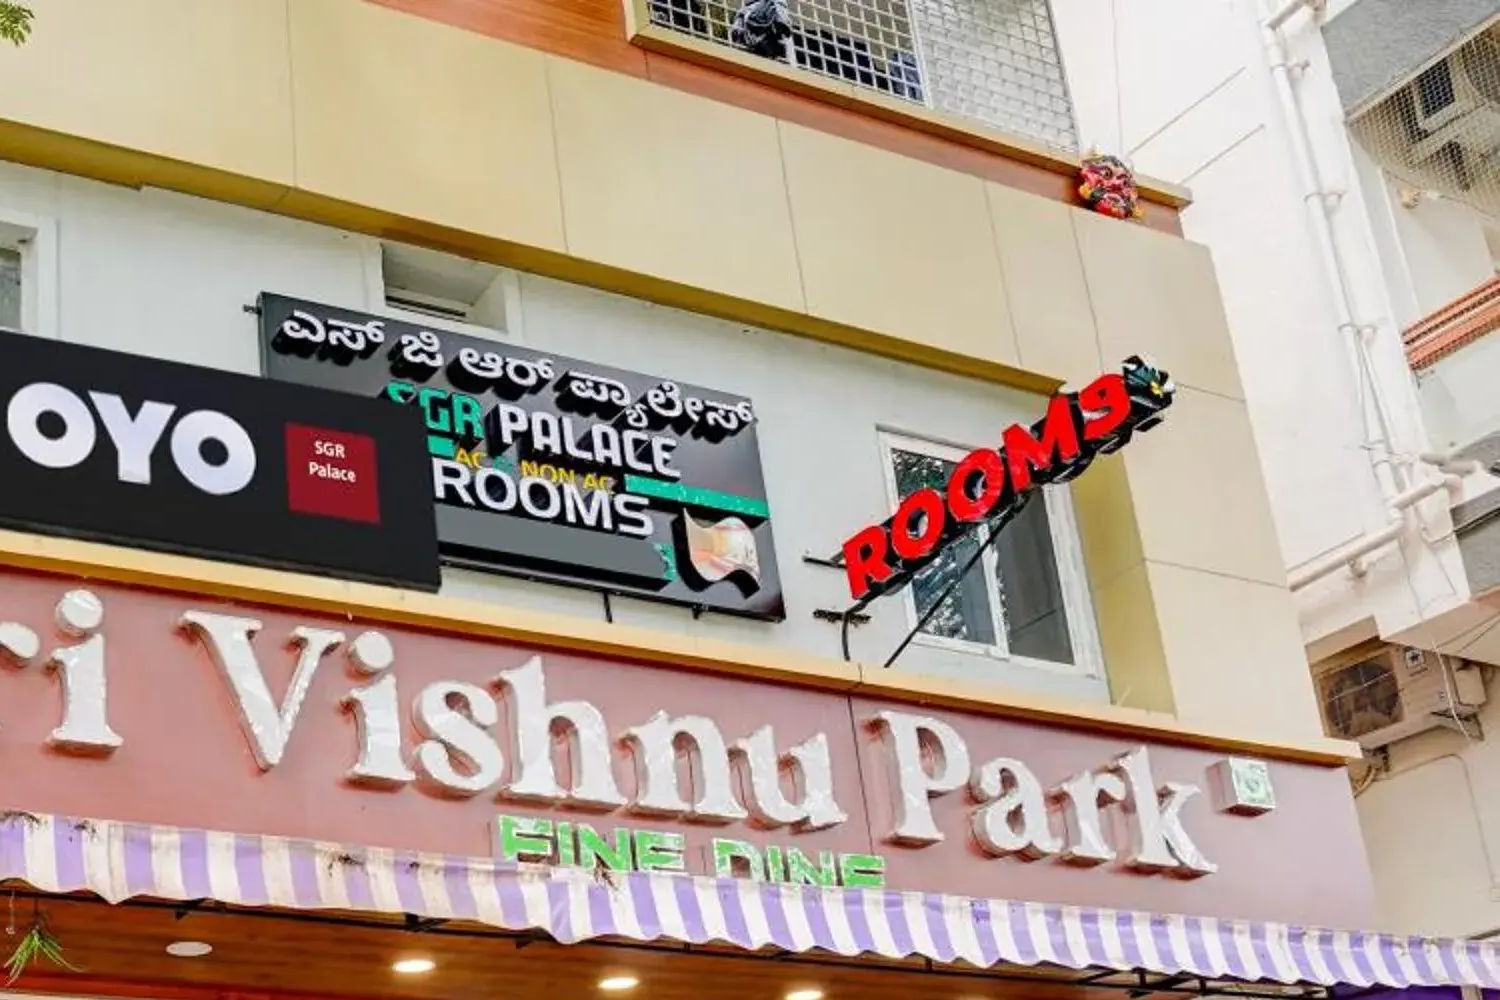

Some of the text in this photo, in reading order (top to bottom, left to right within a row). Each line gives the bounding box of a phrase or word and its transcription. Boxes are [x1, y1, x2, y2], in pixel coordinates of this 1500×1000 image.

[282, 310, 753, 430] ಎಸ್ ಜಿ ಆರ್ ಪ್ಯಾಲೇಸ್
[6, 382, 257, 495] OYO
[309, 462, 357, 484] Palace
[314, 440, 346, 459] SGR
[499, 403, 681, 478] PALACE
[432, 457, 655, 537] ROOMS
[842, 373, 1132, 601] ROOMS
[181, 609, 850, 832] Vishnu
[872, 711, 1220, 878] Park
